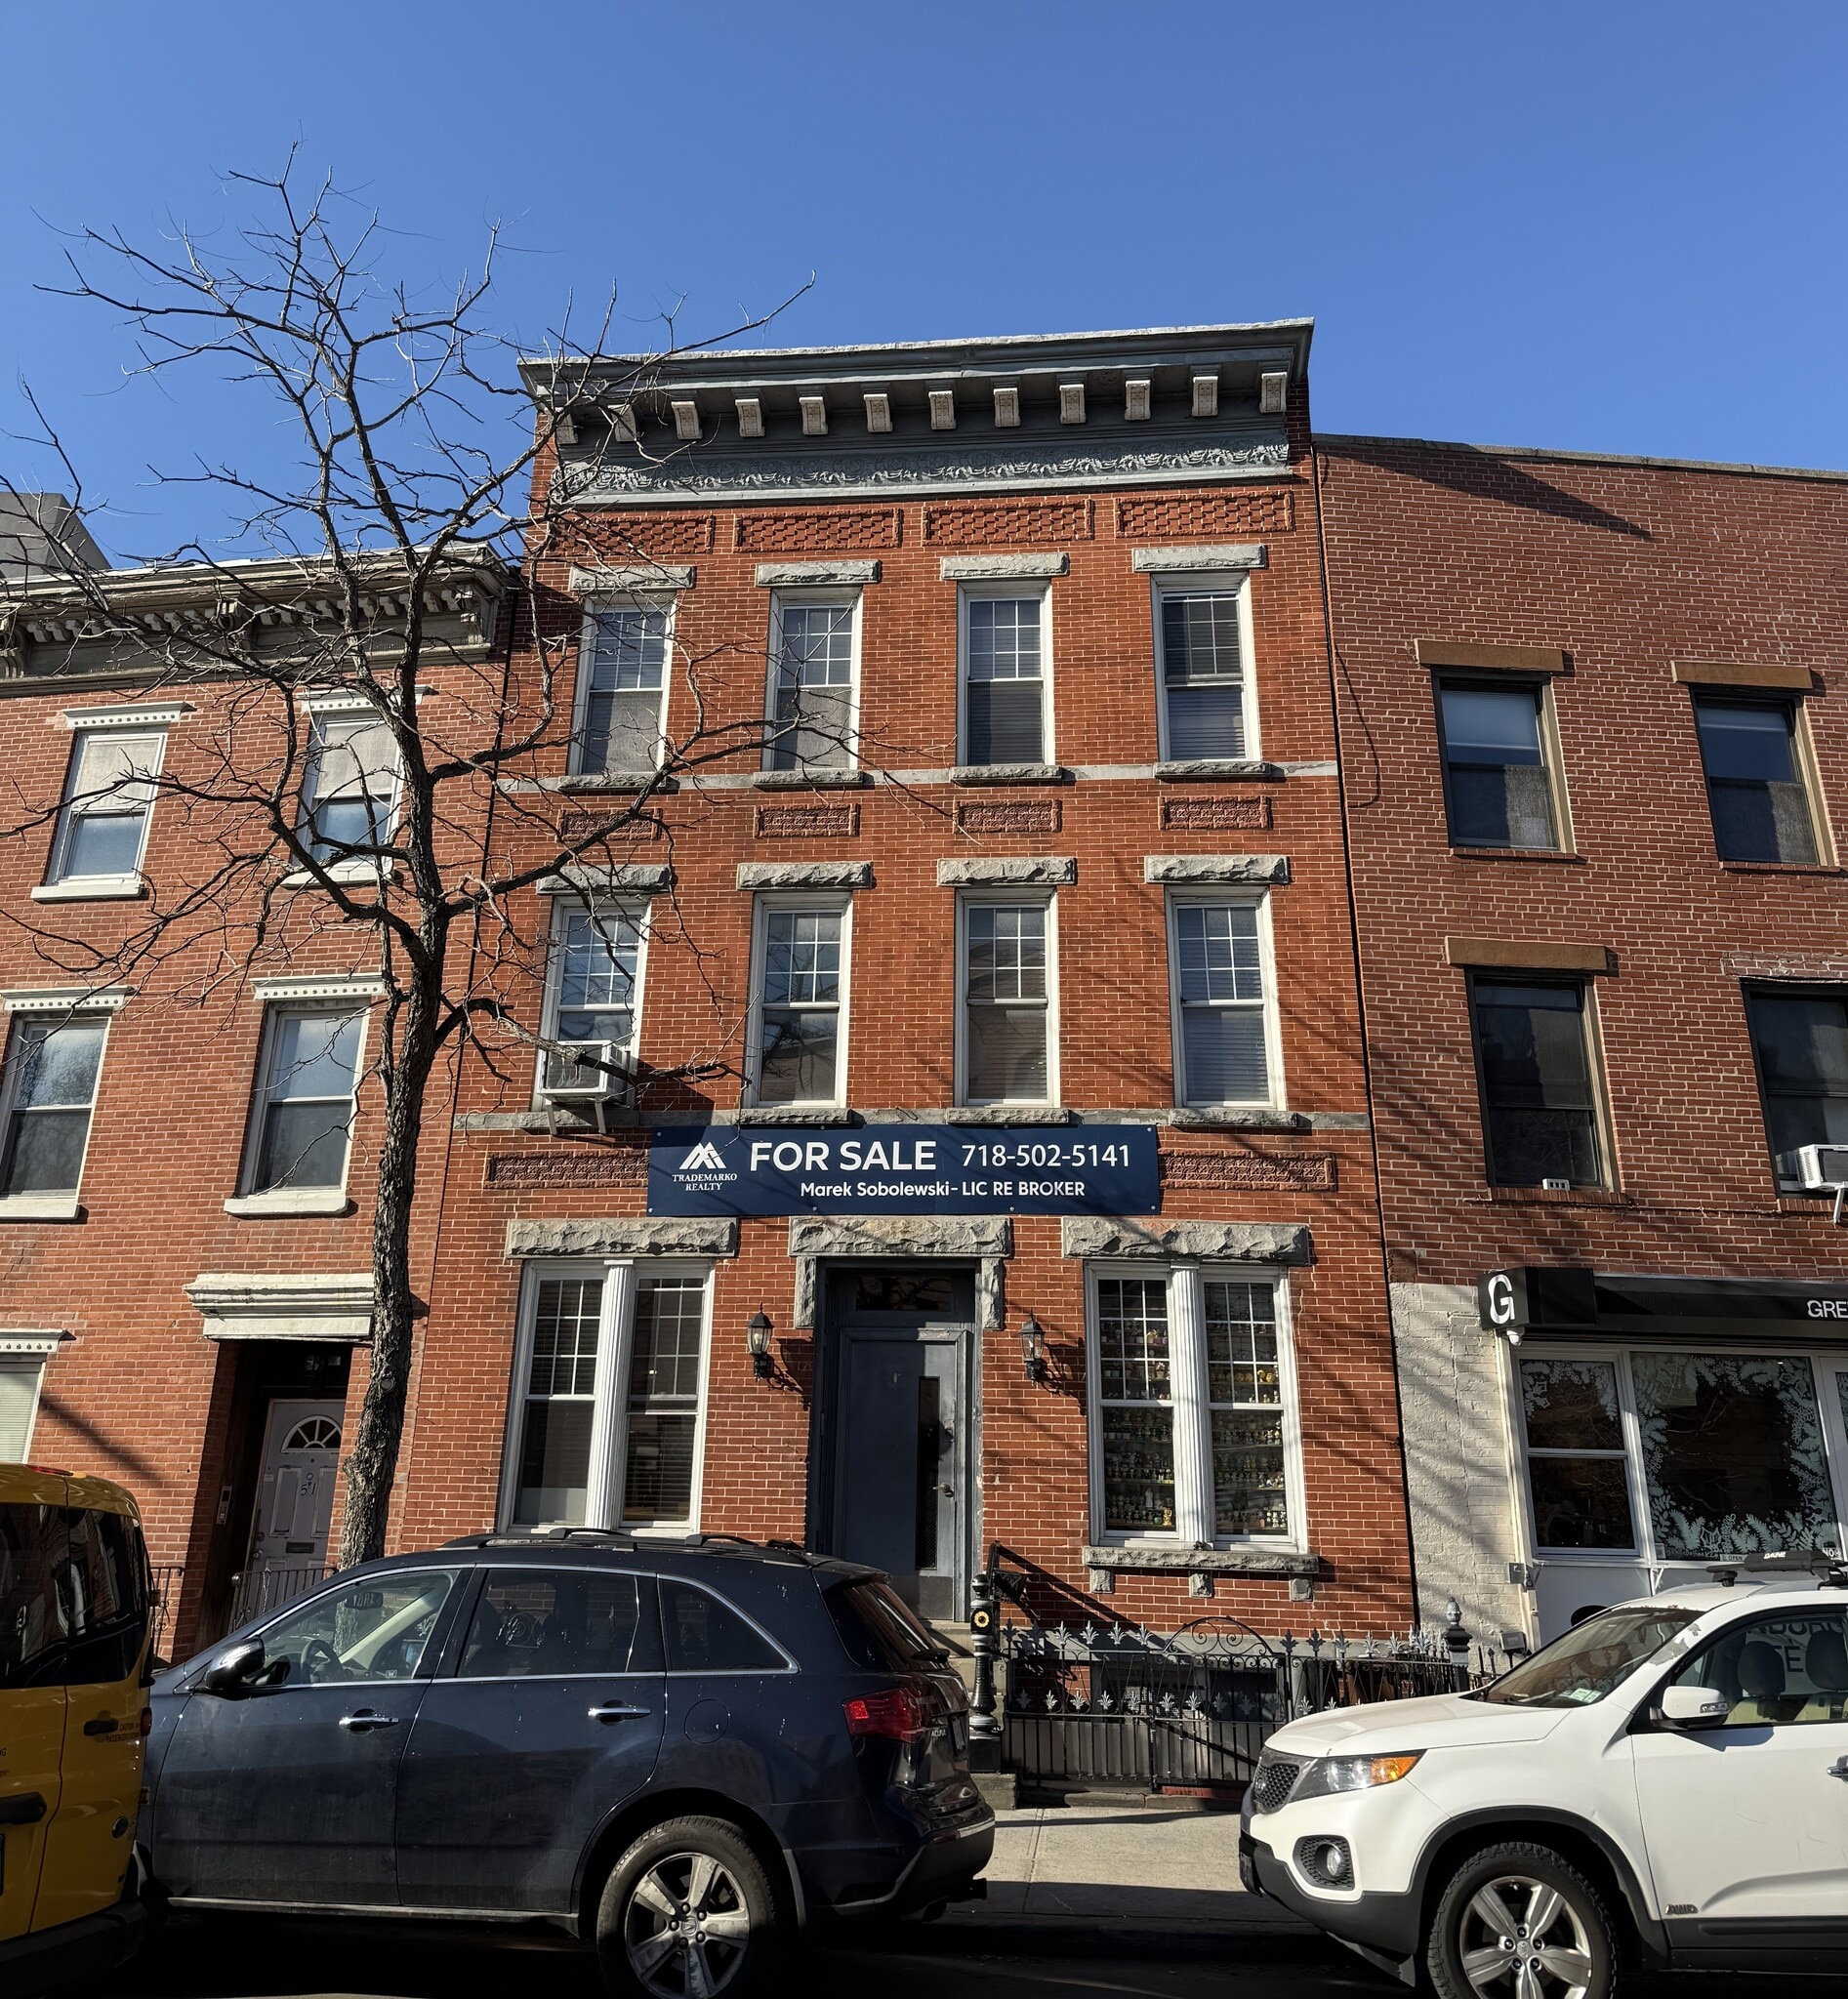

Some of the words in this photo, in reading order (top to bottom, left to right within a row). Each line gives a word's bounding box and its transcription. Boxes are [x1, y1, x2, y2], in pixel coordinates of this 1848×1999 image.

[750, 1141, 830, 1172] FOR
[840, 1140, 937, 1170] SALE
[962, 1144, 1129, 1167] 718-502-5141
[672, 1173, 738, 1182] TRADEMARKO
[685, 1182, 722, 1192] REALTY
[801, 1182, 852, 1197] Marek
[962, 1181, 988, 1196] LIC
[993, 1181, 1013, 1196] RE
[1018, 1181, 1086, 1196] BROKER
[1488, 1274, 1515, 1325] G
